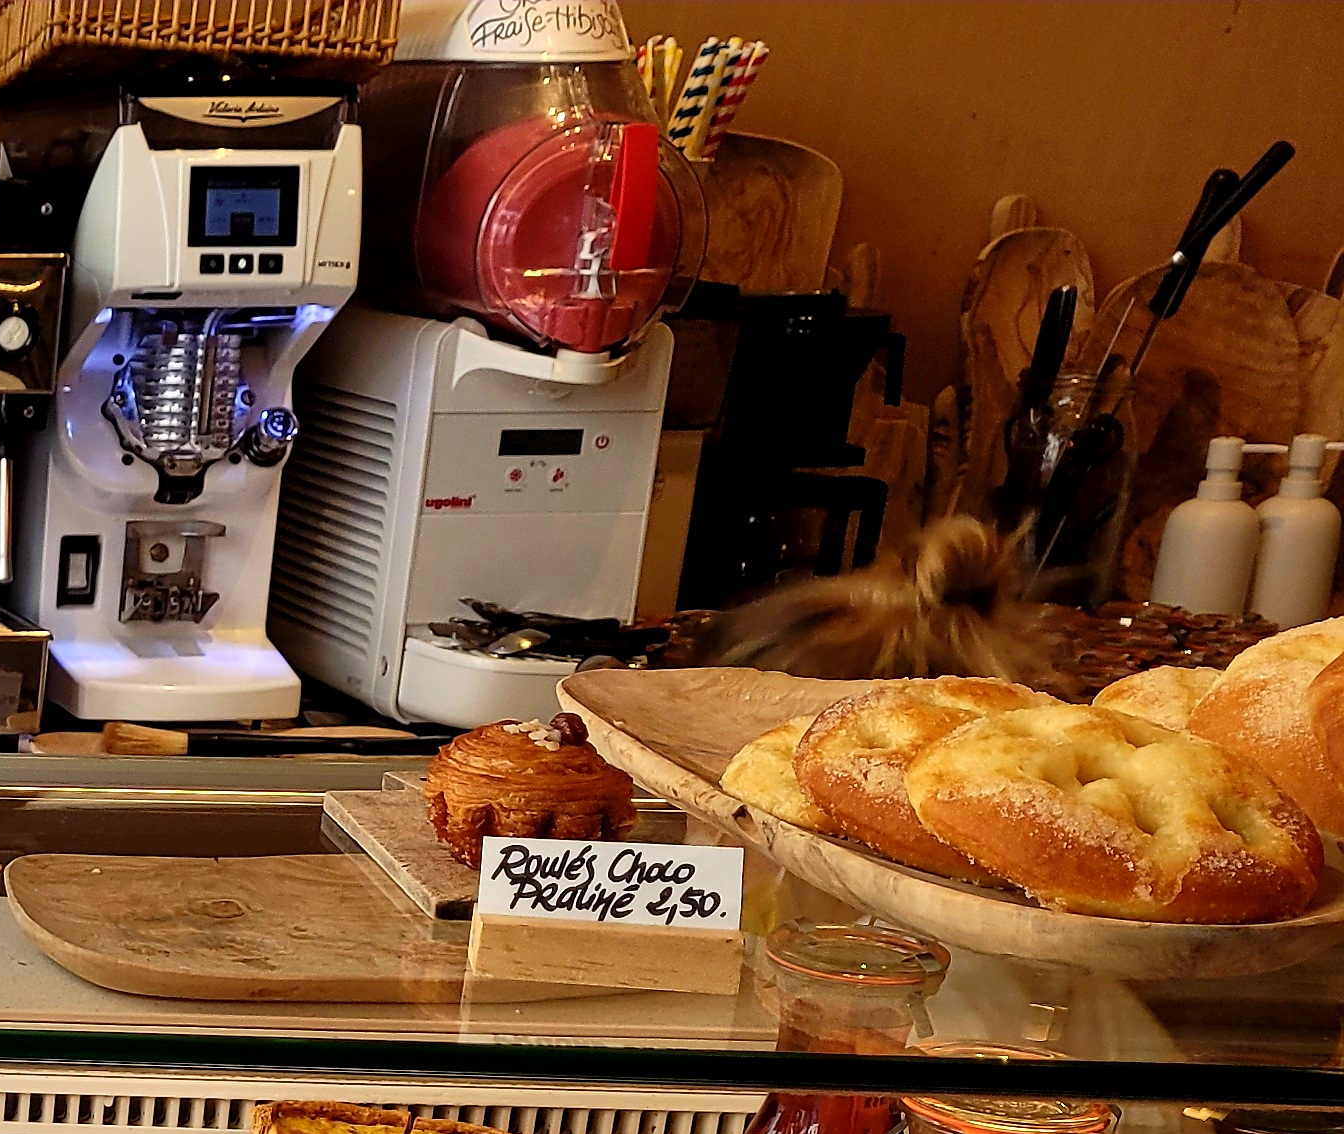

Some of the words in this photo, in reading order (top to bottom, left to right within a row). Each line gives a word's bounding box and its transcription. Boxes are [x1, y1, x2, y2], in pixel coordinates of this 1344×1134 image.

[425, 496, 472, 510] ugolini
[491, 844, 598, 882] Roulés
[607, 848, 696, 884] Choco
[508, 877, 641, 922] Praliné
